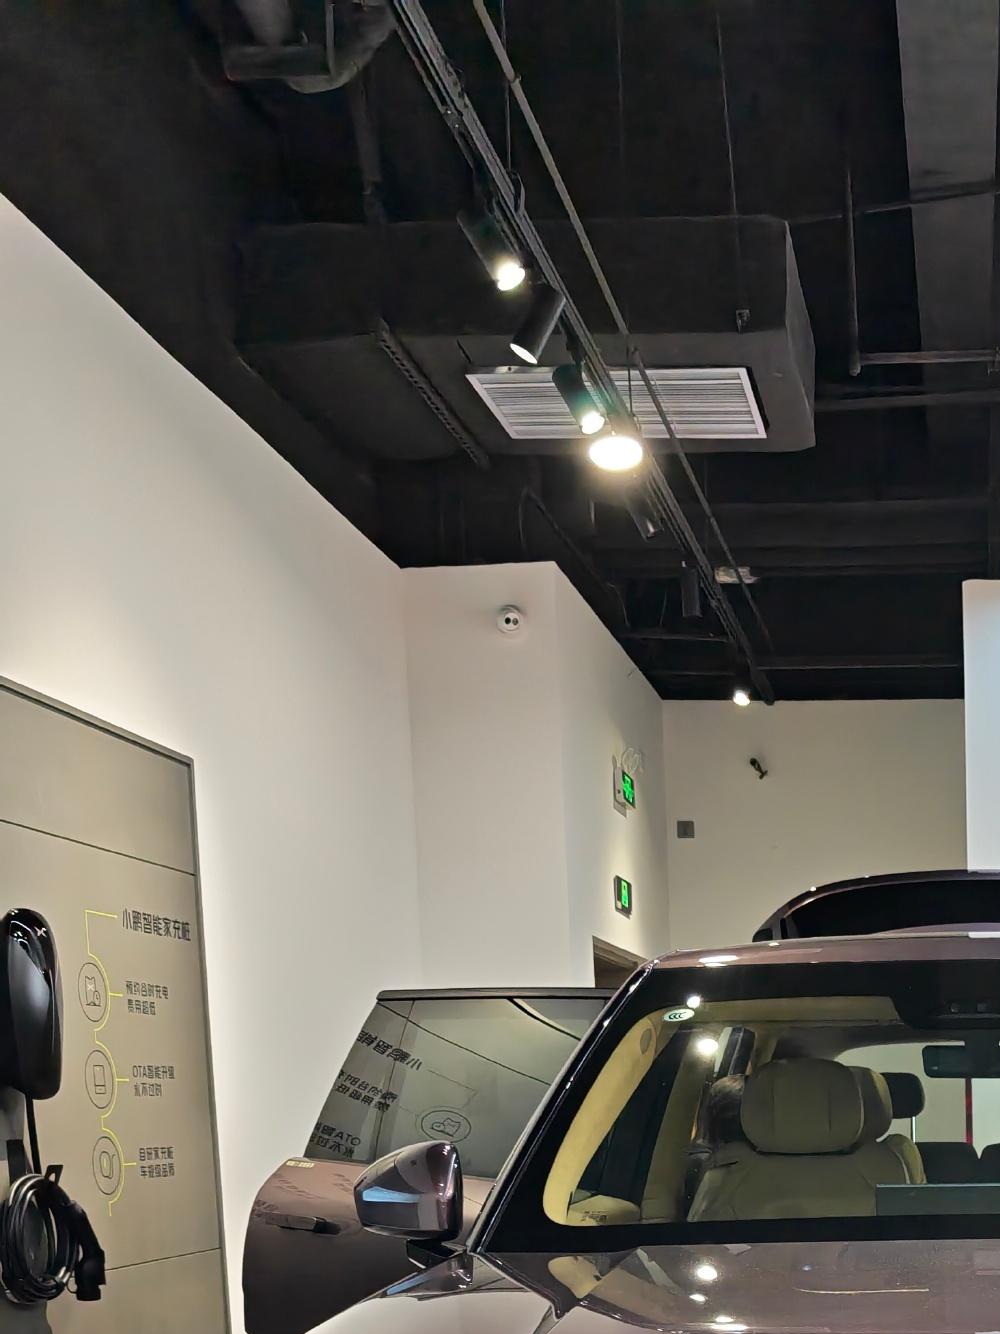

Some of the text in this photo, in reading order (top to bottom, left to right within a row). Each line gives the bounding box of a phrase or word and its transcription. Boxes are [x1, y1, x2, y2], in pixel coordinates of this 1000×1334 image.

[122, 907, 191, 941] 小鹏智能家充桩
